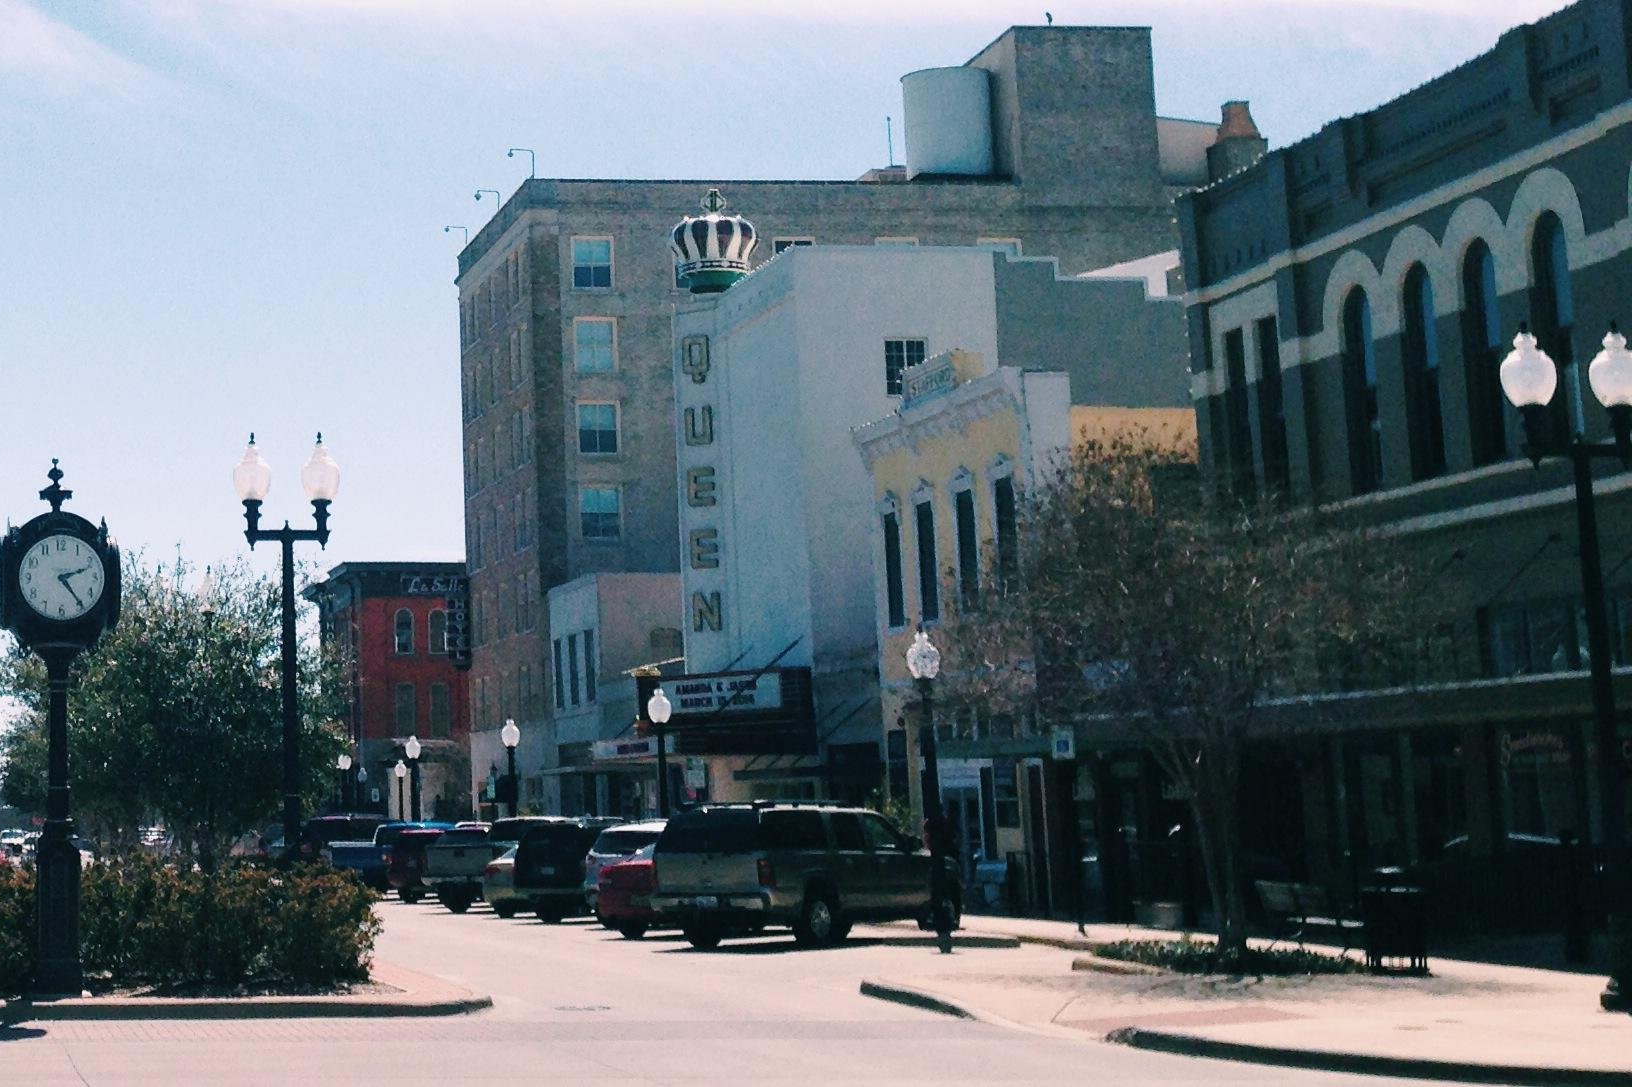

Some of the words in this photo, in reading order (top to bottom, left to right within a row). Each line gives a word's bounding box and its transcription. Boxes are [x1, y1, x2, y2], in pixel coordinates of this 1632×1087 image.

[681, 334, 723, 632] QUEEN
[41, 545, 49, 555] 11
[56, 540, 66, 551] 12
[28, 557, 39, 569] 10
[25, 572, 32, 584] 9
[58, 604, 65, 616] 6
